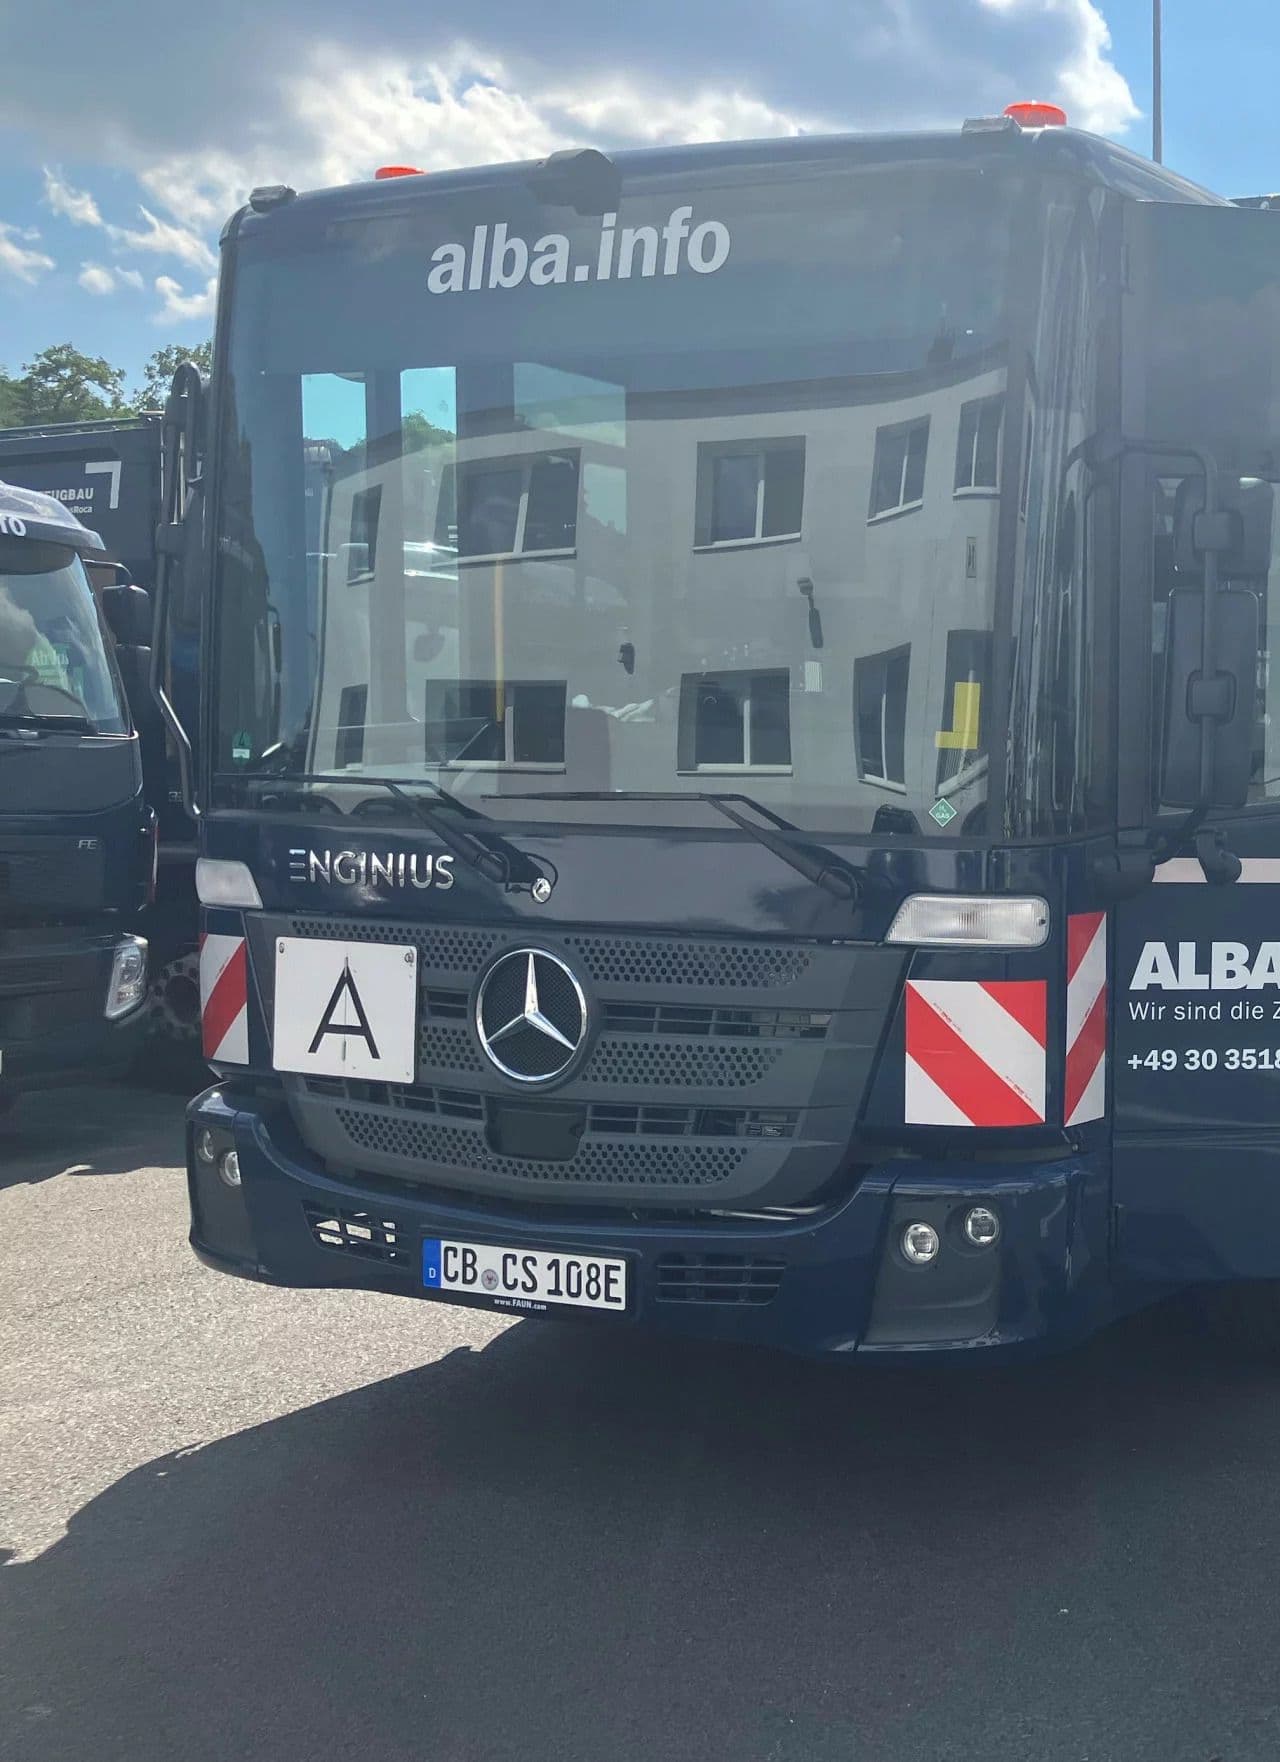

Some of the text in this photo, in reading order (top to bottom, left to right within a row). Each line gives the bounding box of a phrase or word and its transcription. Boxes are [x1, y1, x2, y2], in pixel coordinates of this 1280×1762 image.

[427, 206, 731, 294] alba.info
[289, 848, 455, 890] ENGINIUS
[307, 962, 382, 1060] A
[1128, 1001, 1166, 1021] Wir
[1173, 1001, 1221, 1021] sind
[1230, 1000, 1264, 1020] die
[1127, 1049, 1178, 1072] +49
[1183, 1049, 1218, 1071] 30
[428, 1245, 622, 1304] D CB CS 108E
[494, 1297, 547, 1311] www.FAUN.com
